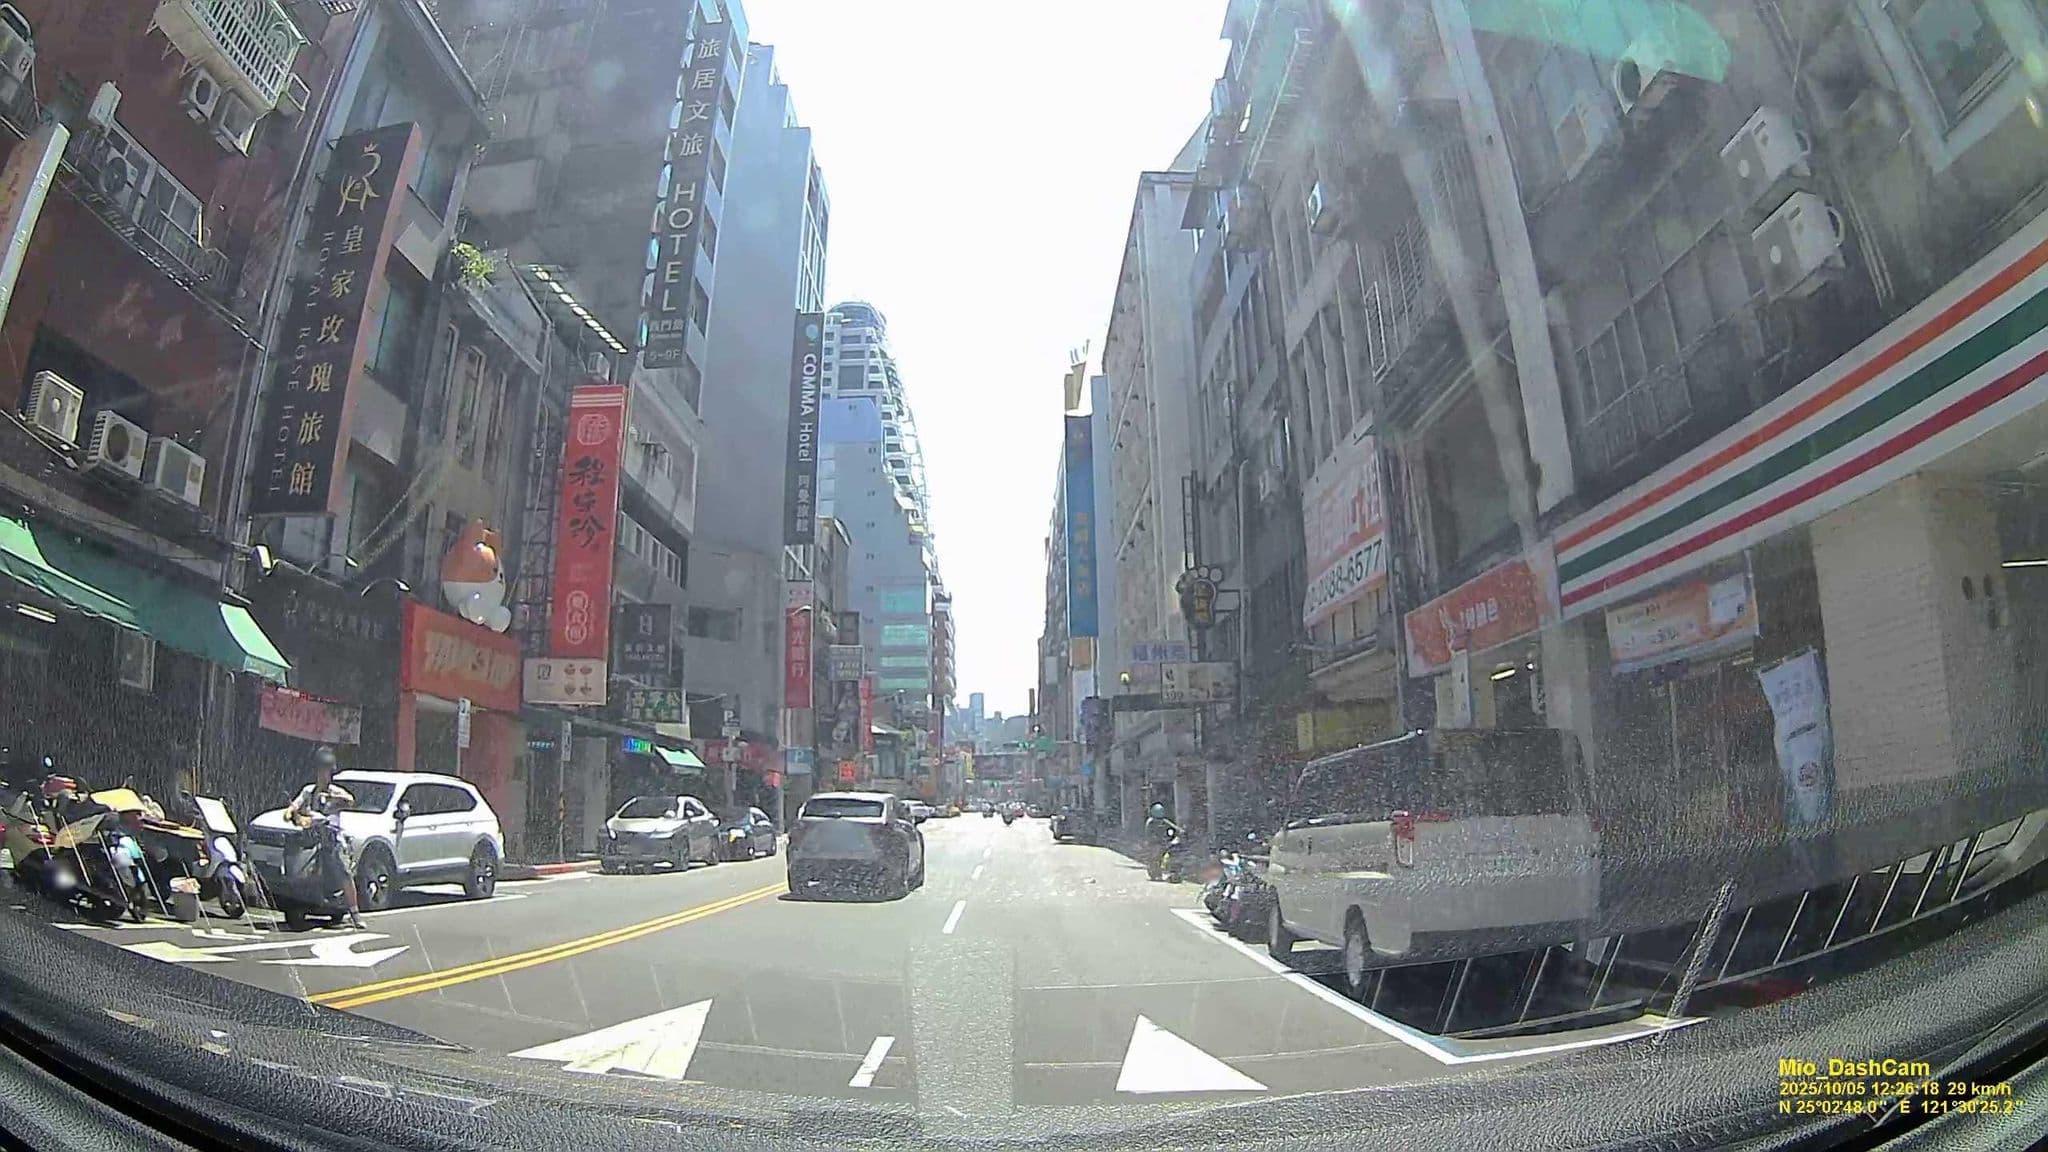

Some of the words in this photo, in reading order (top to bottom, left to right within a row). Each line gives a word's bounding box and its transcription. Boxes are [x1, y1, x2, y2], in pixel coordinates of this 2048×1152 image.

[680, 38, 722, 157] 旅居文旅
[306, 231, 335, 307] ROYAL
[661, 181, 696, 312] HOTEL
[287, 327, 311, 392] ROSE
[288, 224, 364, 496] 皇家玫瑰旅館
[801, 352, 817, 416] COMMA
[269, 404, 295, 492] HOTEL
[798, 422, 813, 462] Hotel
